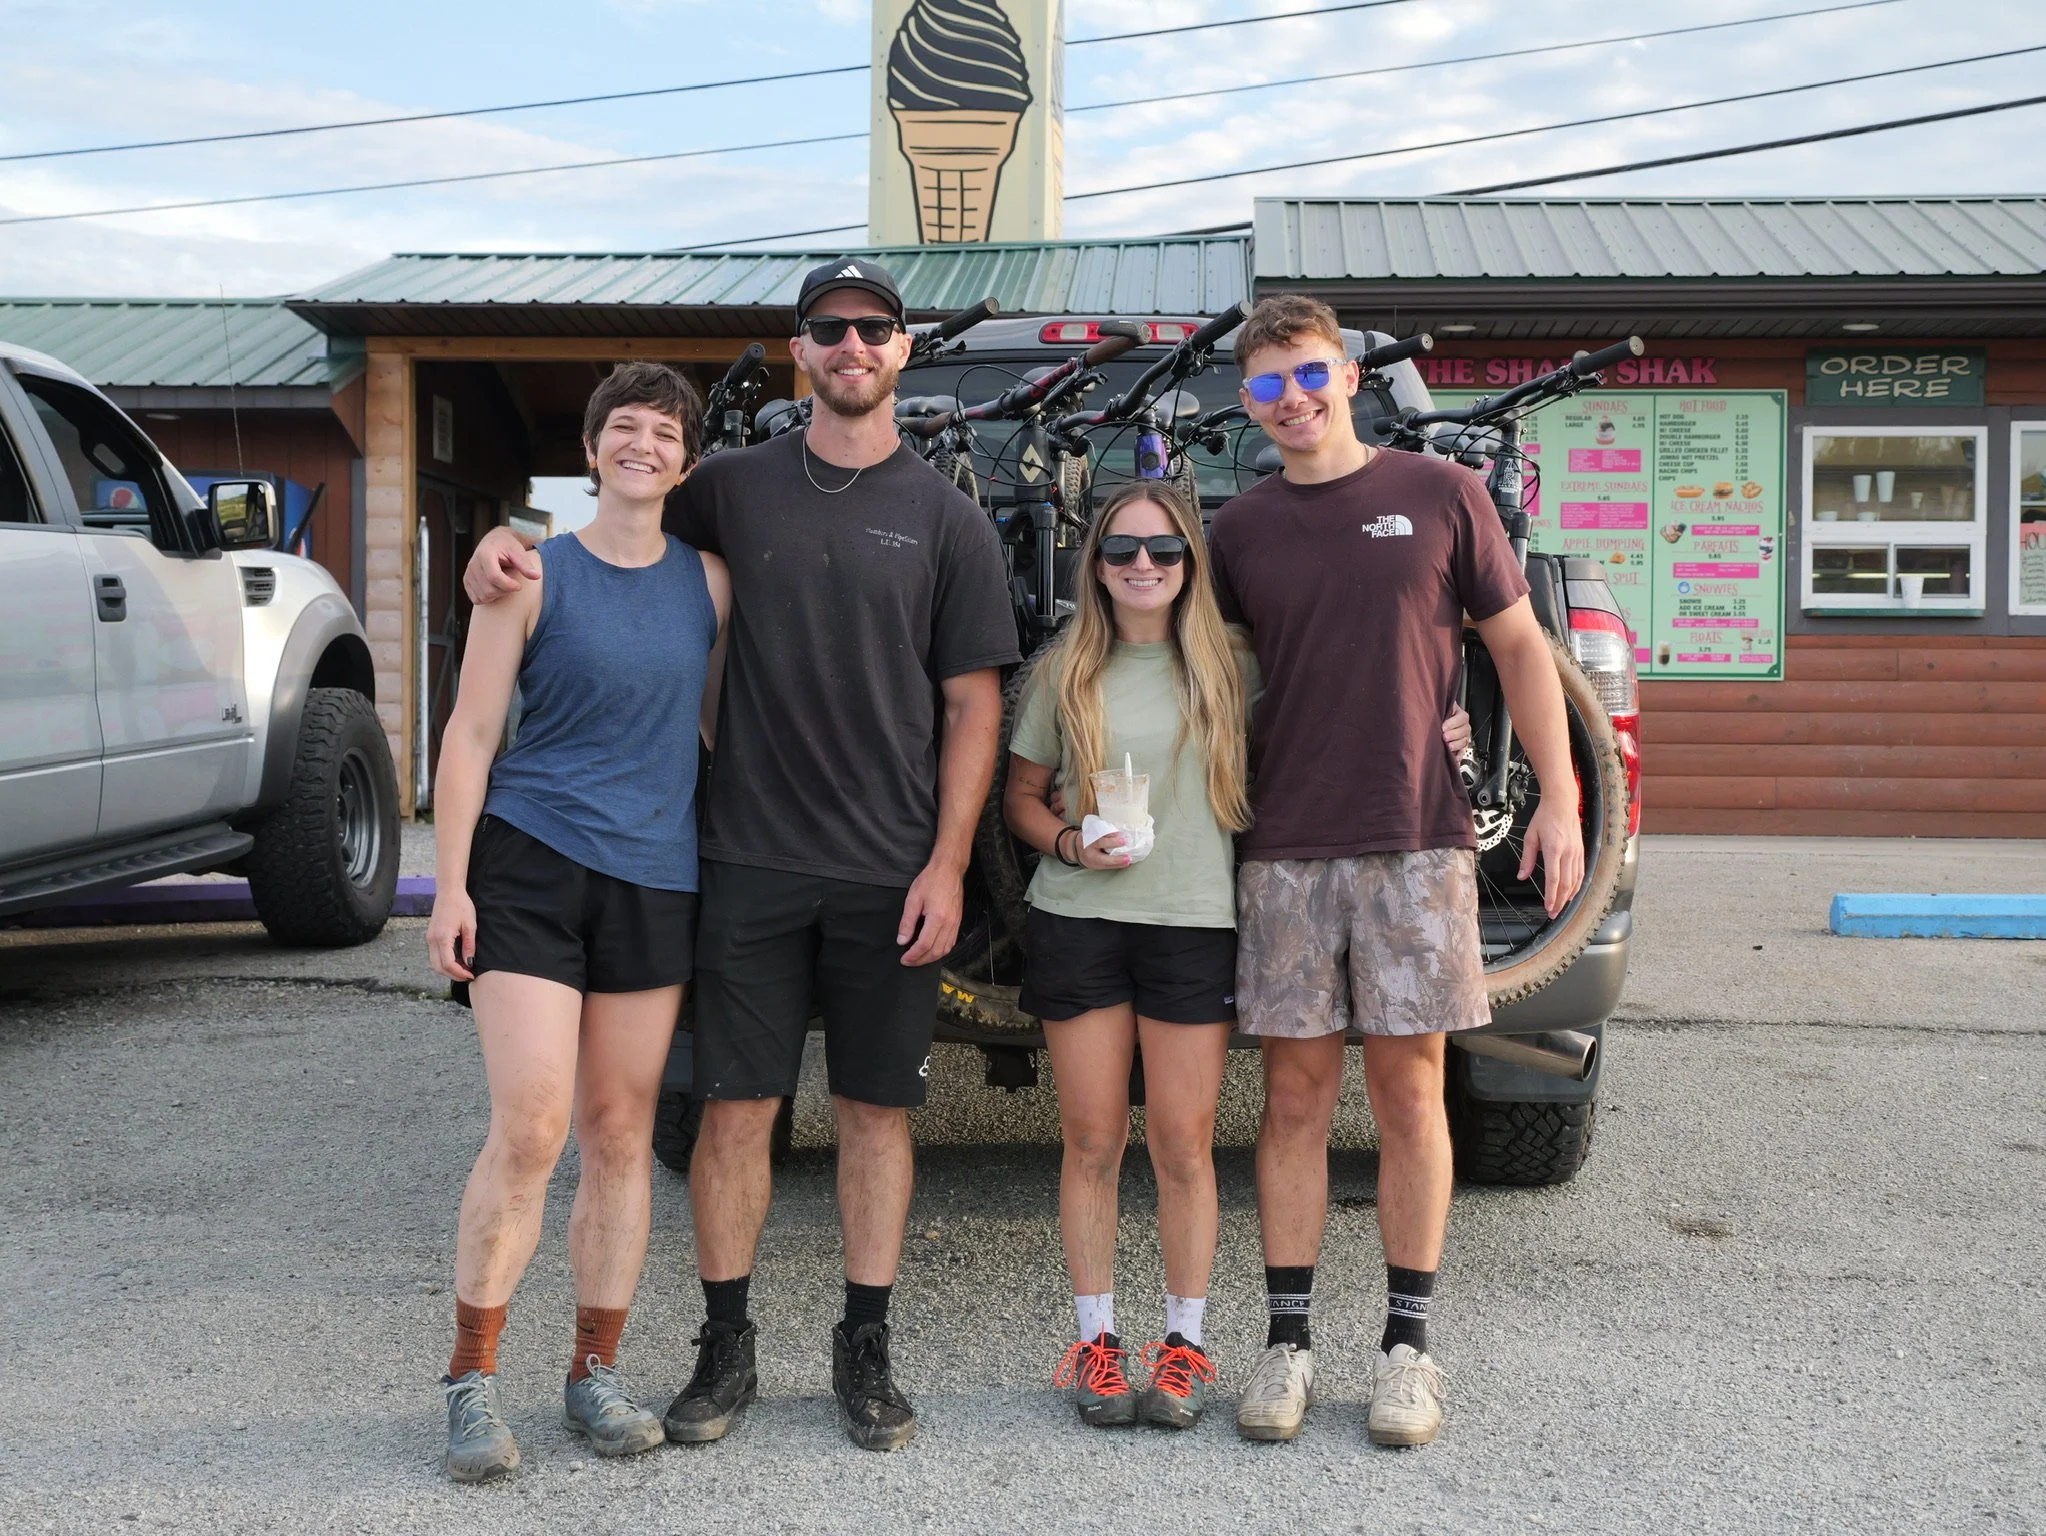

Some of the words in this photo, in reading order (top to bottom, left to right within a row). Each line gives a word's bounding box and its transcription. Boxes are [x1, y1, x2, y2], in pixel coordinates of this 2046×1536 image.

[1413, 357, 1475, 384] THE
[1485, 357, 1608, 385] SHA
[1616, 356, 1718, 384] SHAK
[1820, 354, 1971, 375] ORDER
[1839, 378, 1952, 398] HERE
[1583, 400, 1629, 414] SUNDAES
[1680, 399, 1698, 412] HOT
[1701, 399, 1727, 412] FOOD
[1561, 482, 1600, 492] EXTREME
[1604, 482, 1648, 493] SUNDAES
[1670, 501, 1687, 512] ICE
[1689, 501, 1721, 512] CREAM
[1725, 501, 1764, 513] NACHOS
[1376, 514, 1395, 523] THE
[1362, 522, 1395, 532] NORTH
[1371, 529, 1395, 538] FACE
[1564, 538, 1592, 550] APPLE
[1596, 538, 1645, 551] DUMPLING
[1693, 540, 1739, 553] PARFAITS
[1693, 583, 1739, 596] SNOWIES
[1690, 631, 1722, 643] FLOATS
